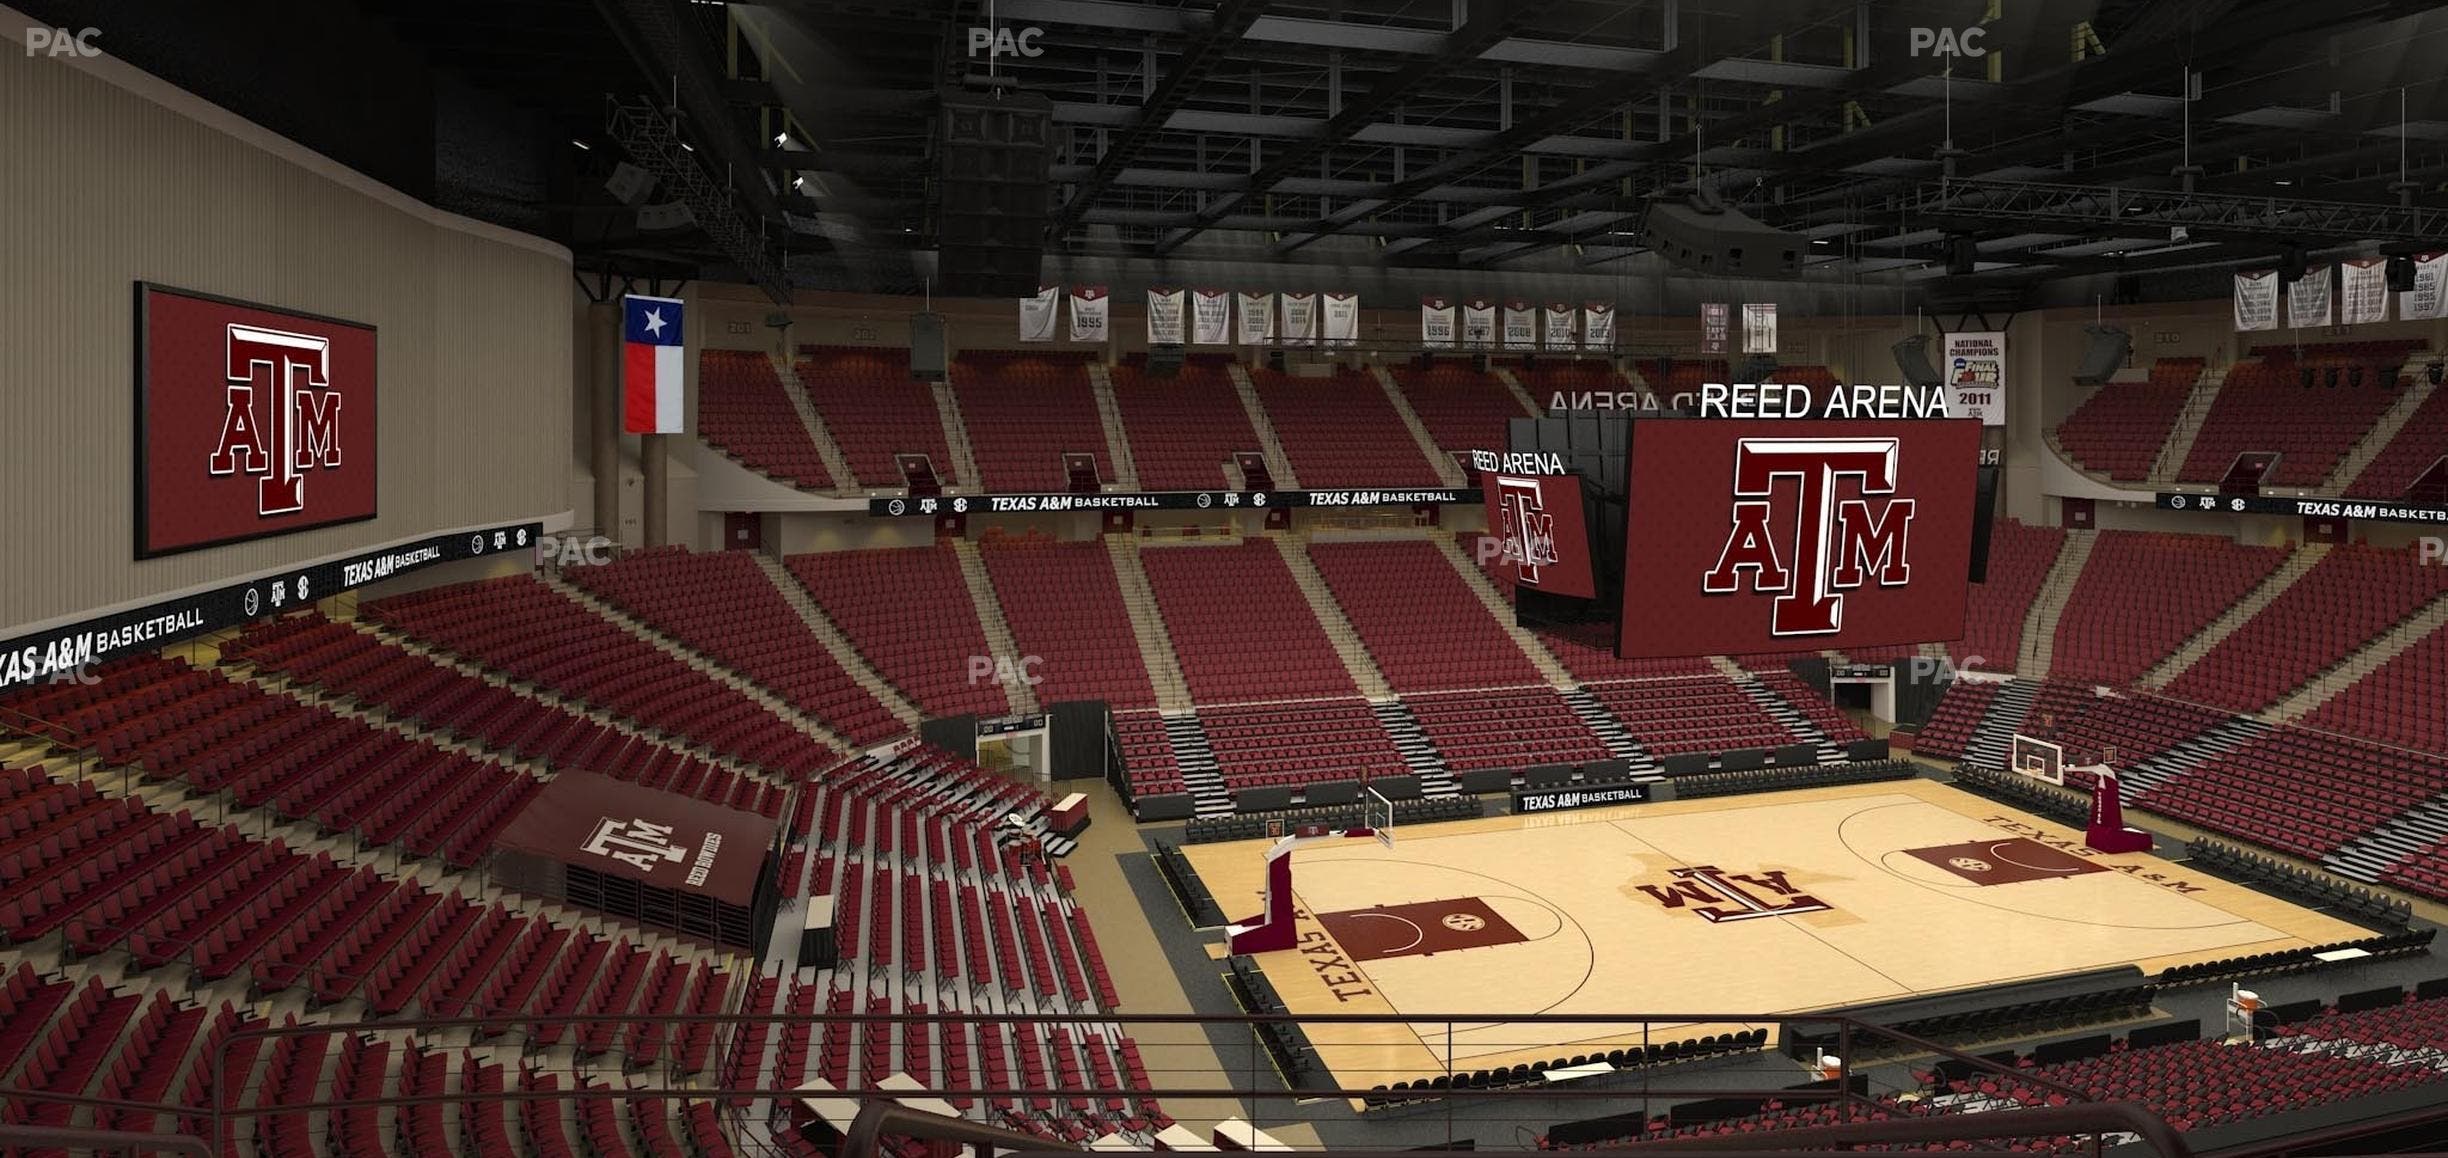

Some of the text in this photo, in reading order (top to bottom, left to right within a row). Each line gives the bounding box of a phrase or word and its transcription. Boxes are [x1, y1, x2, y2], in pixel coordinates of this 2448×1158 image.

[1077, 316, 1102, 328] 1995
[1950, 348, 1999, 357] CHAMPIONS
[1701, 383, 1812, 419] REED
[1823, 385, 1949, 419] ARENA
[1959, 392, 1991, 405] 2011
[1472, 449, 1566, 476] REED ARENA
[992, 497, 1036, 511] TEXAS
[1039, 496, 1073, 510] A&M
[1075, 496, 1159, 507] BASKETBALL
[1310, 492, 1349, 505] TEXAS
[1351, 491, 1380, 505] A&M
[1382, 492, 1456, 503] BASKETBALL
[2297, 502, 2340, 516] TEXAS
[2343, 504, 2377, 518] A&M
[2379, 507, 2448, 521] BASKETB
[42, 631, 93, 676] A&M
[97, 607, 204, 653] BASKETBALL
[343, 559, 374, 588] TEXAS
[374, 554, 395, 580] A&M
[395, 545, 441, 569] BASKETBALL
[1523, 788, 1643, 811] TEXAS A&M BASKETBALL
[1983, 815, 2103, 858] TEXAS
[1296, 931, 1372, 1003] TEXAS
